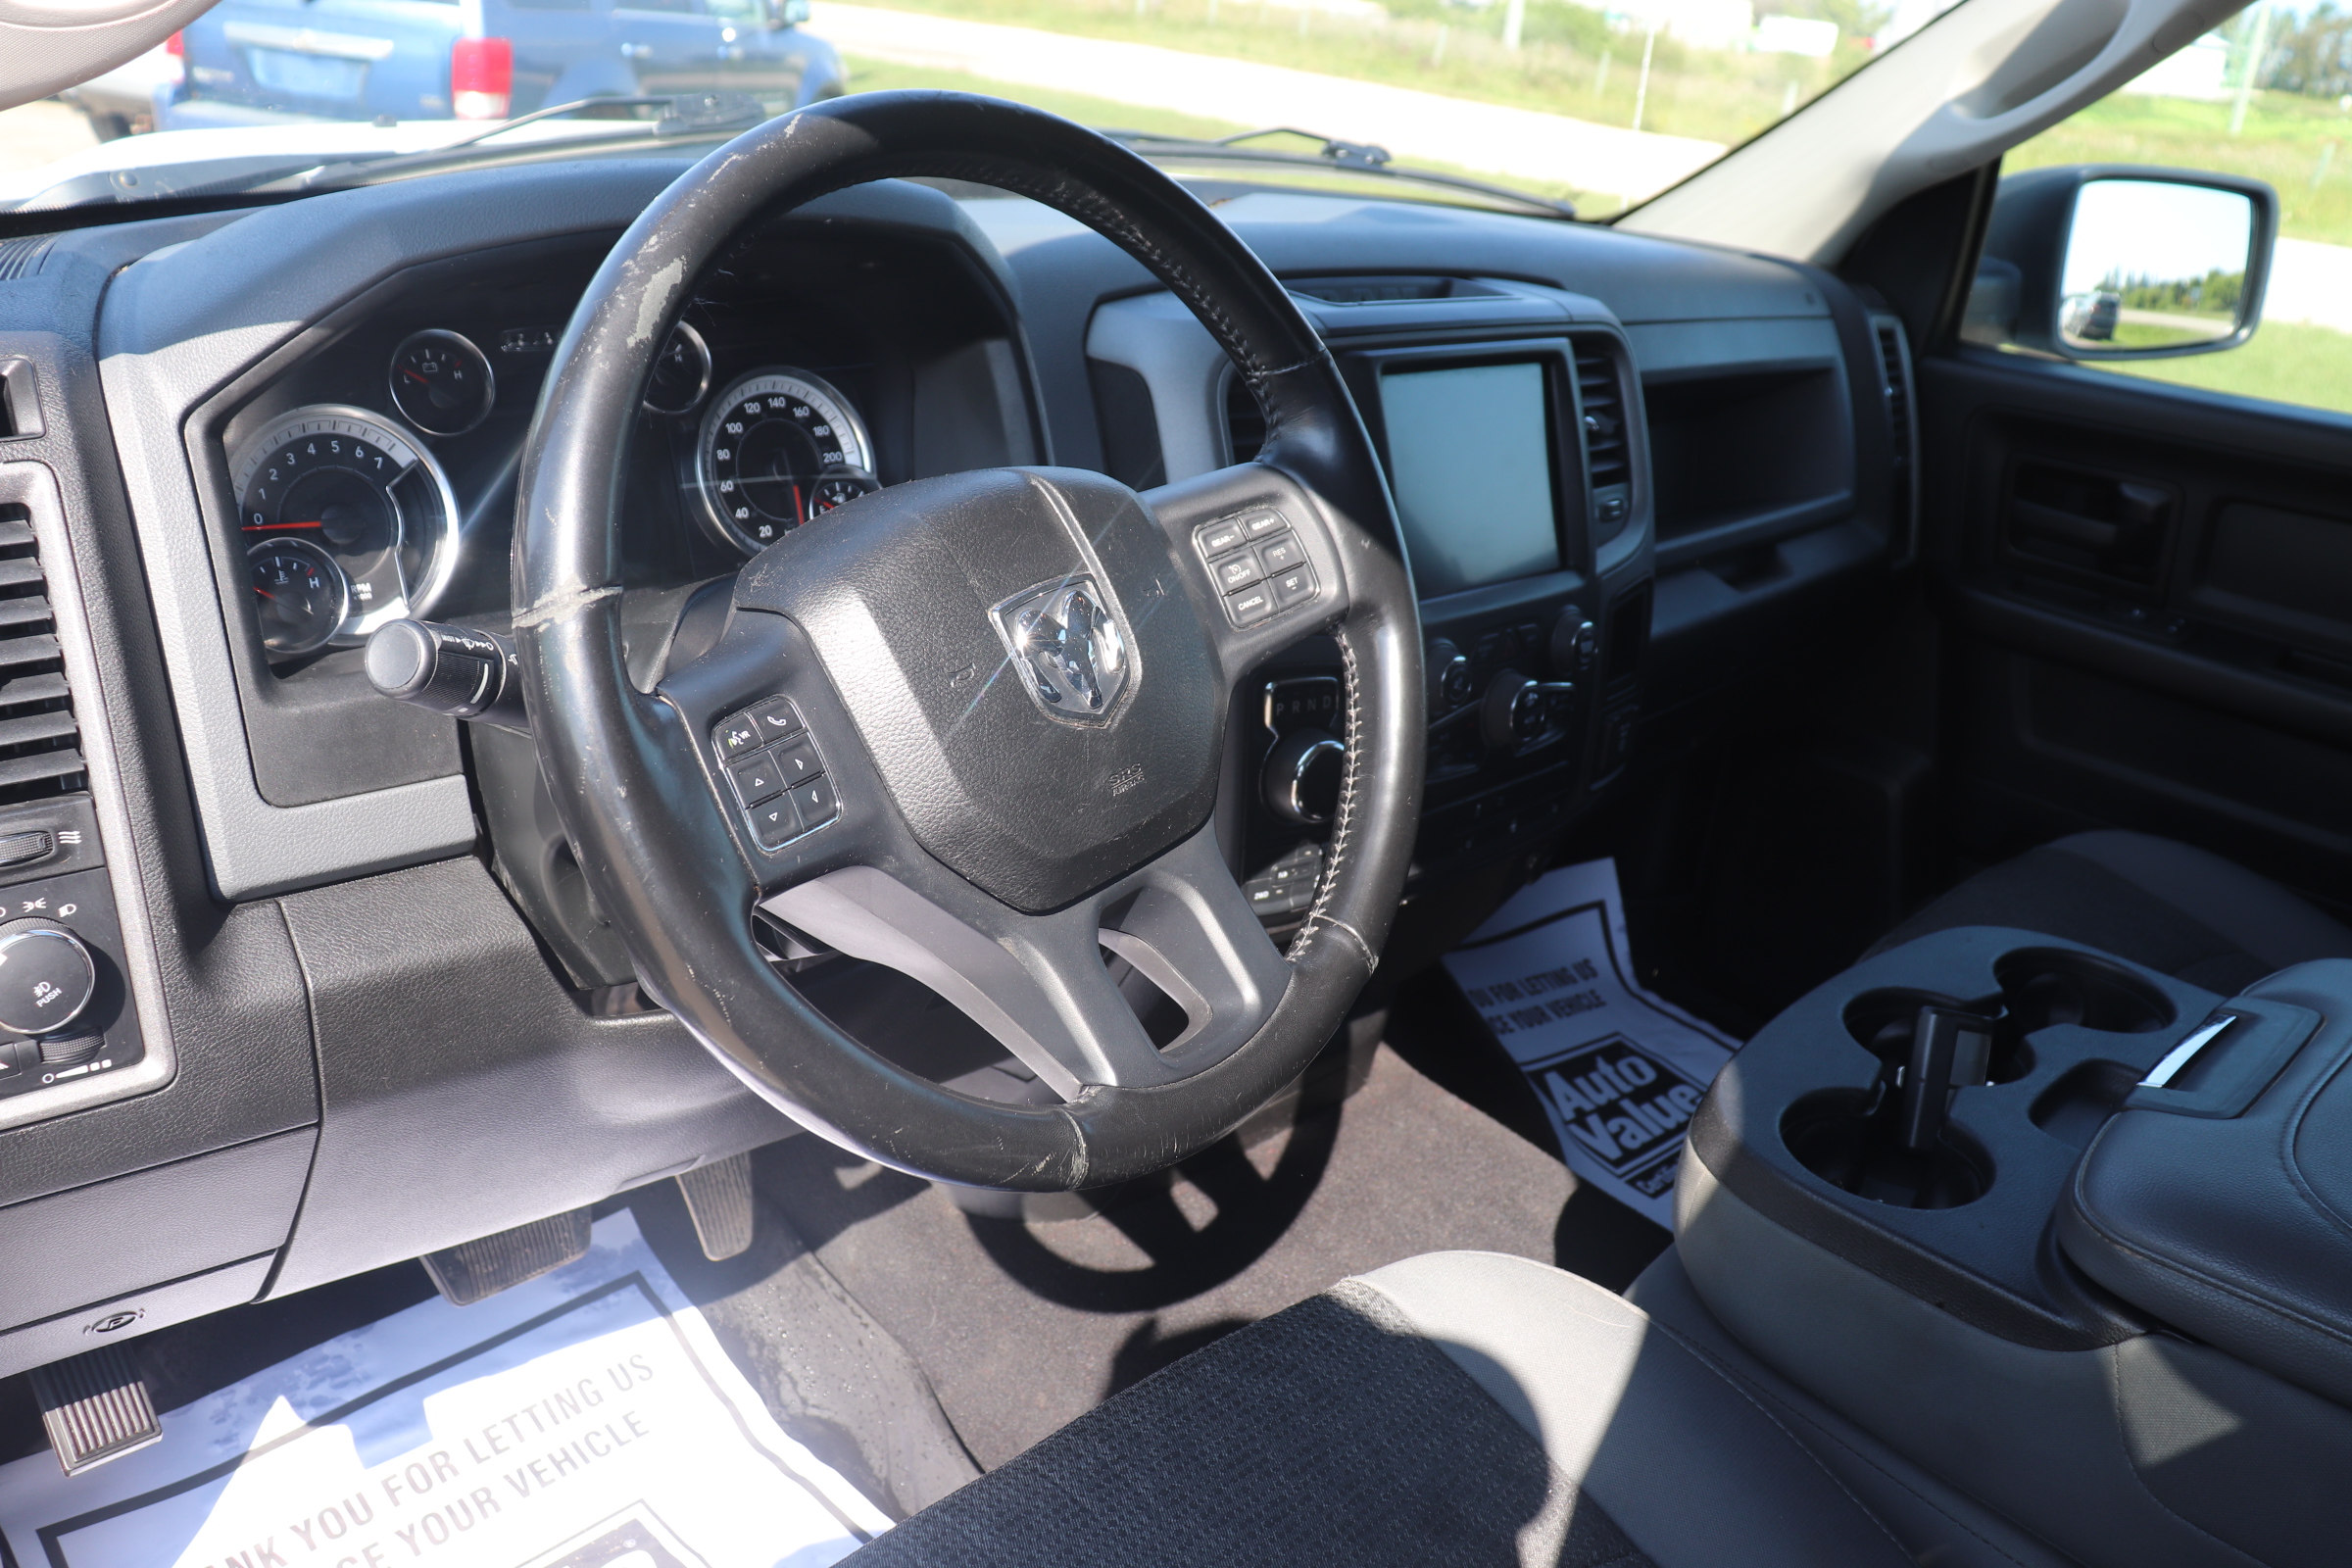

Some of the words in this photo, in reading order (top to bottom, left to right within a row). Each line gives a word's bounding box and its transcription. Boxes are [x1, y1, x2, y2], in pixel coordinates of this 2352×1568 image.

[454, 369, 464, 380] H
[744, 402, 760, 414] 120
[767, 396, 786, 408] 140
[793, 406, 809, 417] 160
[725, 422, 743, 434] 100
[812, 424, 830, 436] 180
[307, 443, 316, 454] 4
[331, 441, 340, 453] 5
[355, 446, 365, 458] 6
[287, 453, 296, 465] 3
[716, 449, 730, 461] 80
[823, 451, 843, 463] 200
[374, 457, 383, 468] 7
[270, 468, 278, 480] 2
[720, 480, 733, 492] 60
[259, 488, 267, 500] 1
[253, 513, 264, 524] 0
[735, 507, 749, 519] 40
[759, 524, 772, 537] 20
[1272, 547, 1286, 558] RES
[309, 576, 319, 588] H
[350, 582, 372, 593] RPM
[1285, 576, 1298, 588] SET
[1238, 596, 1263, 611] CANCEL
[1489, 981, 1525, 1003] FOR
[1517, 966, 1579, 996] LETTING
[1572, 957, 1598, 981] US
[36, 987, 62, 1007] PUSH
[1507, 1005, 1553, 1030] YOUR
[1545, 989, 1607, 1018] VEHICLE
[1544, 1055, 1657, 1122] Auto
[1568, 1084, 1699, 1161] Value
[289, 1493, 374, 1552] YOU
[381, 1449, 460, 1507] FOR
[464, 1377, 606, 1465] LETTING
[607, 1353, 655, 1393] US
[395, 1486, 503, 1558] YOUR
[503, 1410, 650, 1498] VEHICLE
